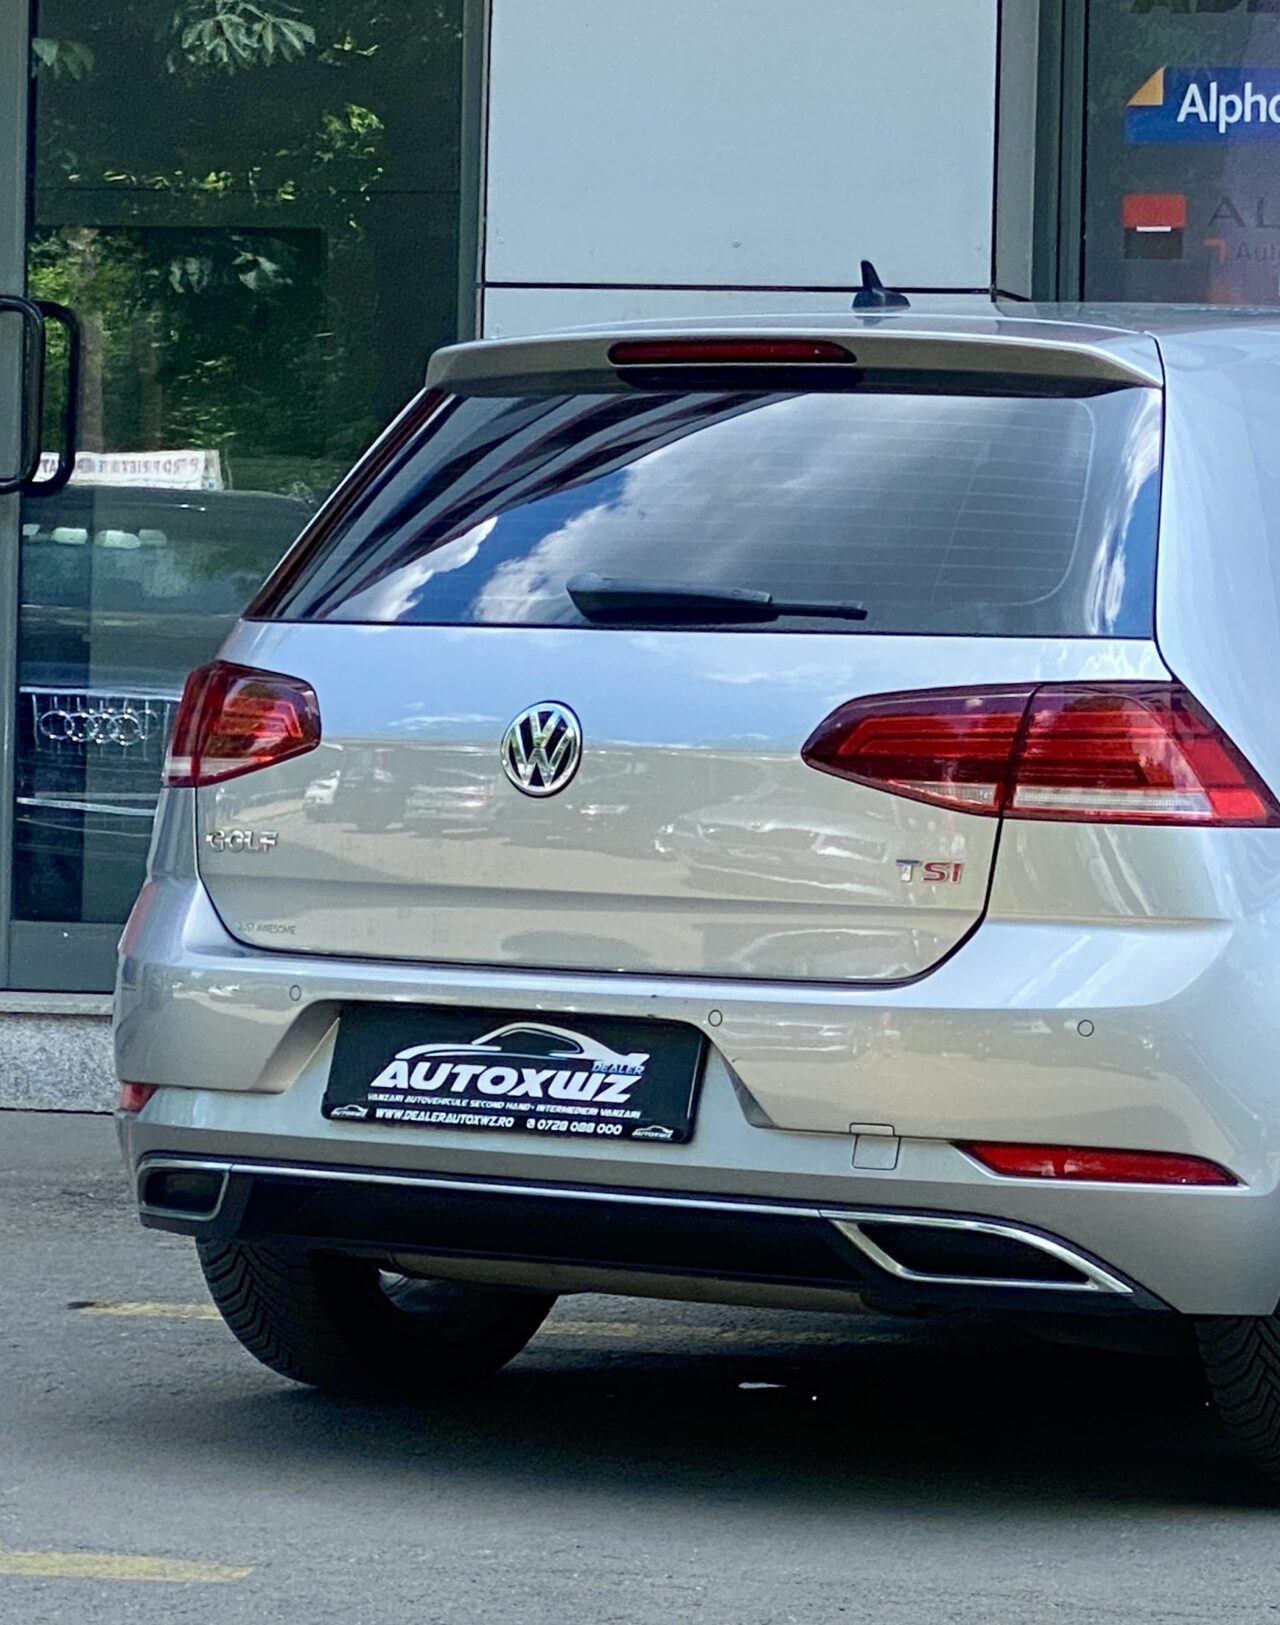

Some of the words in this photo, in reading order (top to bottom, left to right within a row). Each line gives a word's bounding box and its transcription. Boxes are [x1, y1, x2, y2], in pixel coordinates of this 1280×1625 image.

[206, 829, 279, 853] GOLF
[895, 859, 964, 884] TSI
[592, 1061, 645, 1076] DEALER
[370, 1060, 643, 1103] AUTOXWZ
[367, 1093, 404, 1104] VANZARI
[404, 1094, 469, 1107] AUTOVEHICULE
[469, 1099, 503, 1109] SECOND
[536, 1104, 599, 1116] INTERMEDIERI
[600, 1108, 642, 1119] VANZARI
[375, 1108, 516, 1128] WWW.DEALERAUTOXWZ.RO
[596, 1123, 623, 1135] 000
